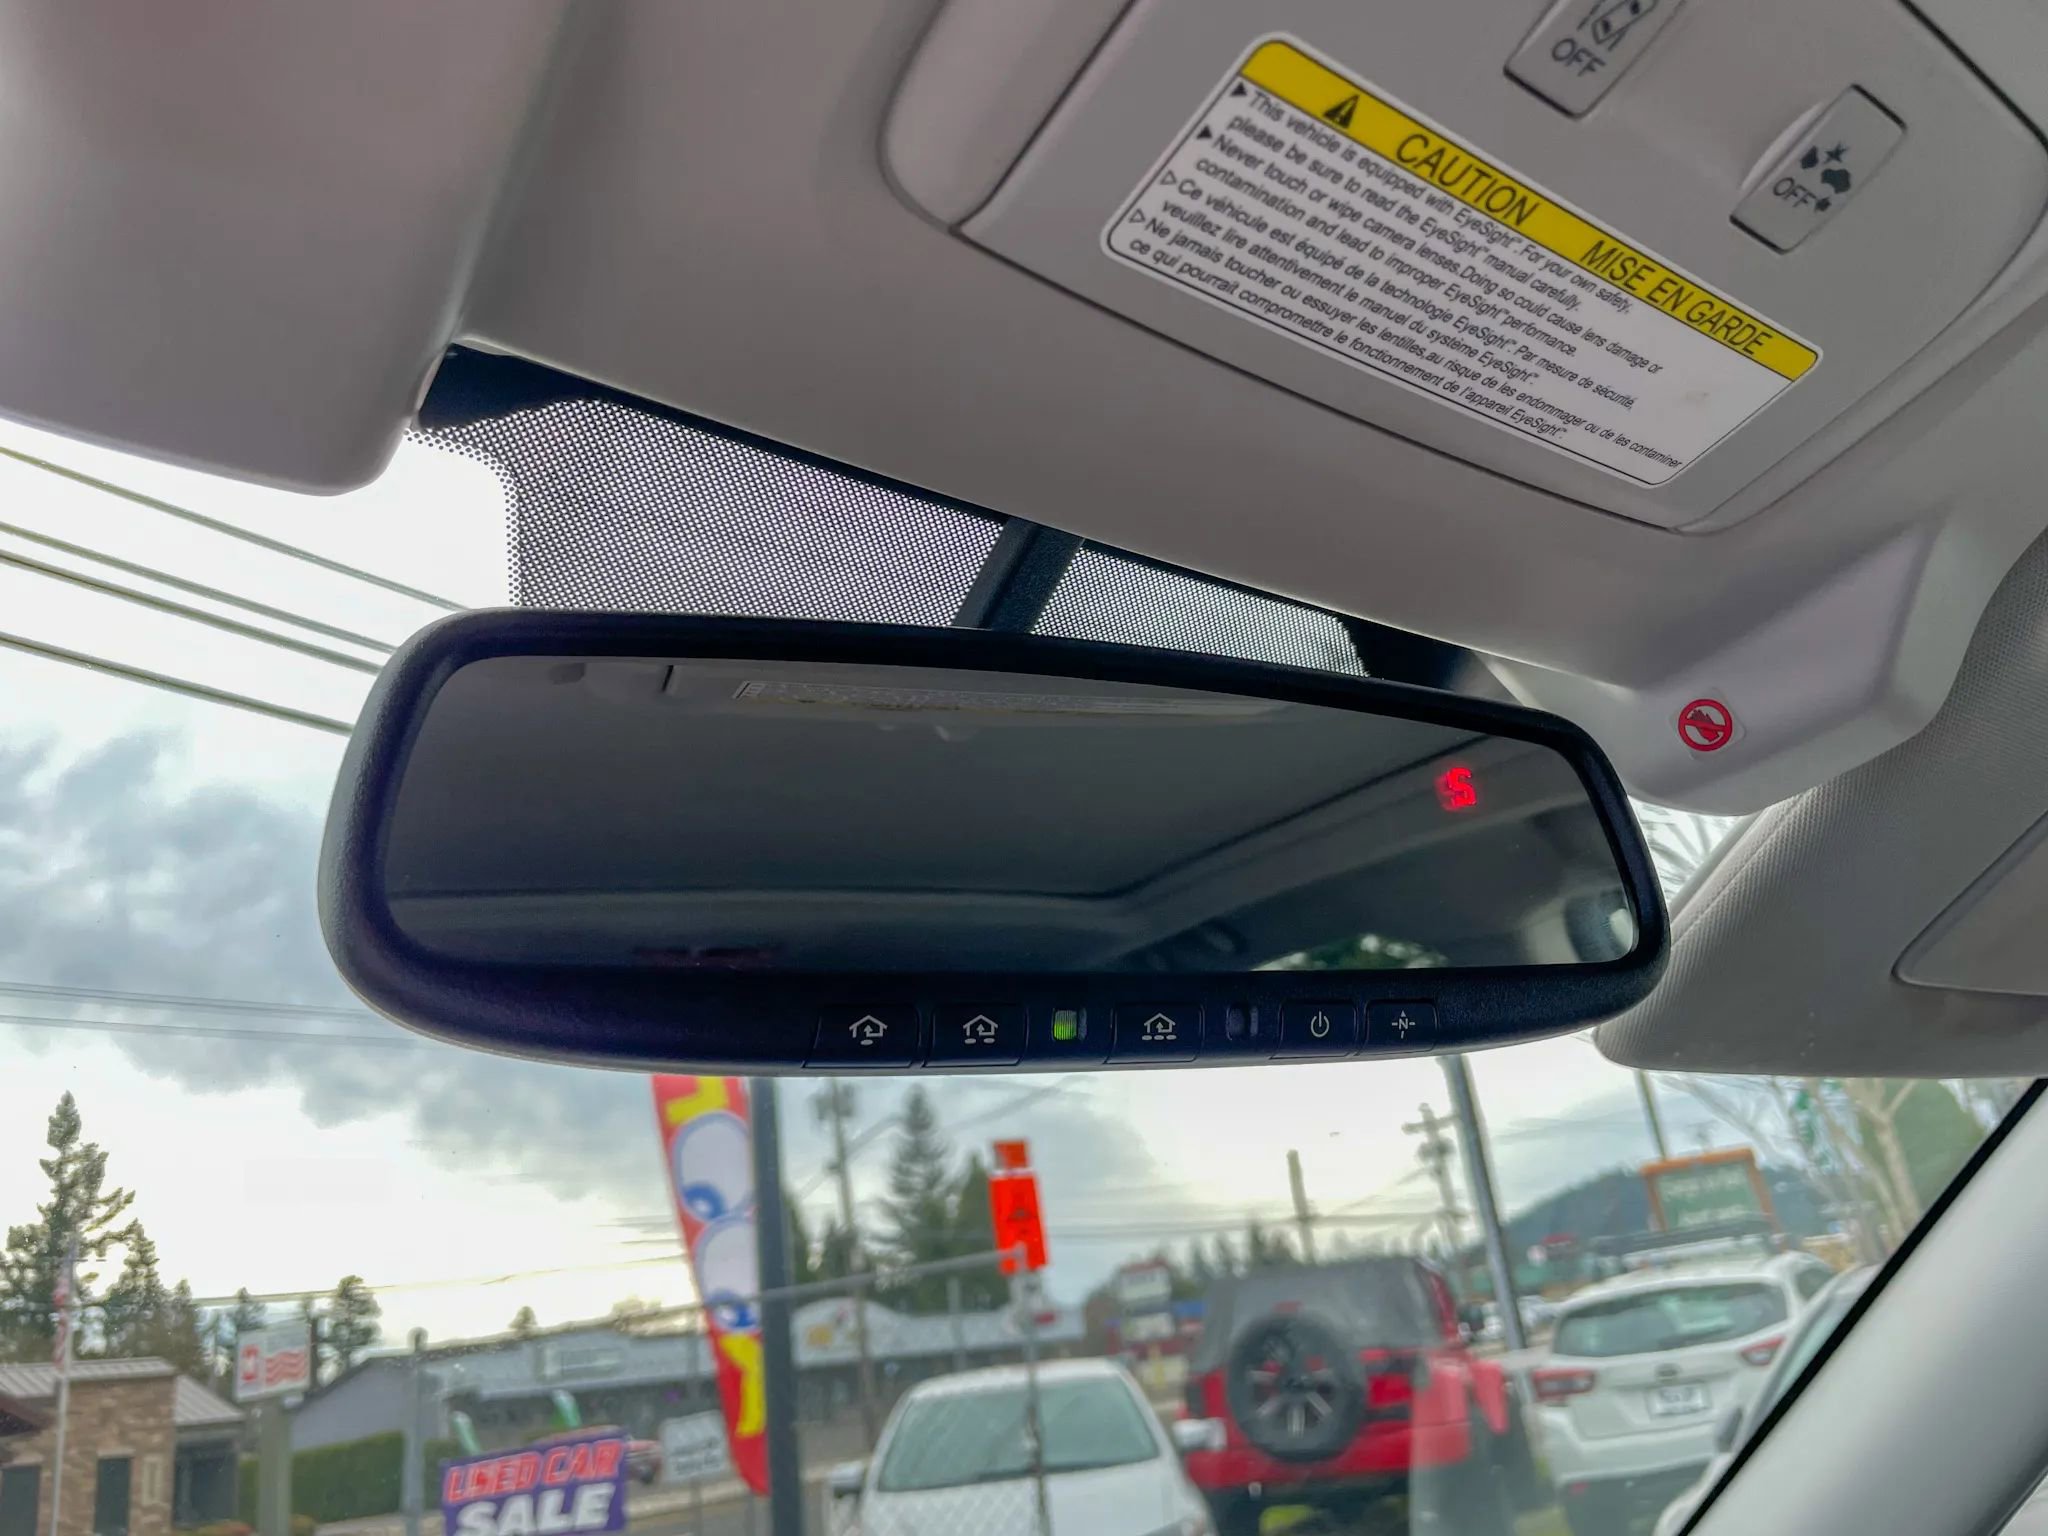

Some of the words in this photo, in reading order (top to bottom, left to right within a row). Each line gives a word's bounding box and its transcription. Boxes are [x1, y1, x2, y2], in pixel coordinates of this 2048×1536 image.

[1551, 37, 1606, 77] OFF
[1195, 158, 1307, 221] contamination
[1305, 215, 1340, 237] and
[1335, 228, 1372, 253] lead
[1367, 245, 1385, 261] to
[1384, 253, 1447, 290] improper
[1226, 115, 1285, 153] please
[1284, 143, 1308, 165] be
[1307, 159, 1344, 185] sure
[1343, 176, 1362, 194] to
[1360, 188, 1399, 213] read
[1394, 204, 1421, 226] the
[1483, 254, 1535, 284] manual
[1529, 278, 1582, 312] carefully.
[1254, 91, 1286, 121] This
[1286, 116, 1341, 154] vehicle
[1340, 145, 1358, 163] is
[1356, 157, 1428, 200] equipped
[1424, 193, 1455, 216] with
[1538, 258, 1574, 279] your
[1569, 274, 1598, 293] own
[1396, 134, 1538, 227] CAUTION
[1773, 176, 1818, 208] OFF
[1129, 239, 1151, 255] ce
[1152, 249, 1182, 268] qui
[1175, 262, 1240, 296] pourrait
[1238, 289, 1335, 338] compromettre
[1333, 330, 1349, 345] le
[1348, 337, 1446, 387] fonctionnement
[1442, 380, 1461, 394] de
[1162, 200, 1223, 238] veuillez
[1221, 227, 1248, 250] lire
[1247, 244, 1347, 297] attentivement
[1343, 287, 1359, 303] le
[1358, 297, 1413, 326] manuel
[1408, 319, 1429, 335] du
[1426, 329, 1480, 358] système
[1177, 178, 1204, 201] Ce
[1205, 194, 1269, 234] véhicule
[1269, 228, 1297, 247] est
[1294, 238, 1347, 270] équipé
[1343, 264, 1365, 280] de
[1363, 272, 1381, 288] la
[1379, 280, 1454, 323] technologie
[1513, 344, 1539, 362] Par
[1535, 357, 1579, 382] mesure
[1577, 377, 1594, 389] de
[1213, 133, 1265, 170] Never
[1263, 162, 1309, 195] touch
[1307, 188, 1329, 203] or
[1327, 197, 1363, 223] wipe
[1362, 217, 1417, 251] camera
[1496, 287, 1516, 302] so
[1513, 295, 1552, 318] could
[1546, 312, 1583, 335] cause
[1580, 328, 1608, 347] lens
[1605, 342, 1650, 369] damage
[1647, 363, 1664, 374] or
[1578, 240, 1648, 291] MISE
[1646, 278, 1691, 311] EN
[1687, 302, 1772, 355] GARDE
[1145, 217, 1171, 239] Ne
[1166, 230, 1224, 264] jamais
[1224, 255, 1283, 289] toucher
[1280, 284, 1302, 300] ou
[1301, 294, 1358, 325] essuyer
[1355, 316, 1379, 335] les
[1442, 359, 1482, 381] risque
[1480, 376, 1499, 389] de
[1496, 382, 1518, 397] les
[1515, 392, 1588, 427] endommager
[1584, 423, 1601, 434] ou
[1598, 428, 1615, 440] de
[1612, 433, 1631, 447] les
[1628, 442, 1683, 468] contaminer
[454, 1482, 616, 1536] SALE
[542, 1439, 625, 1486] CAR
